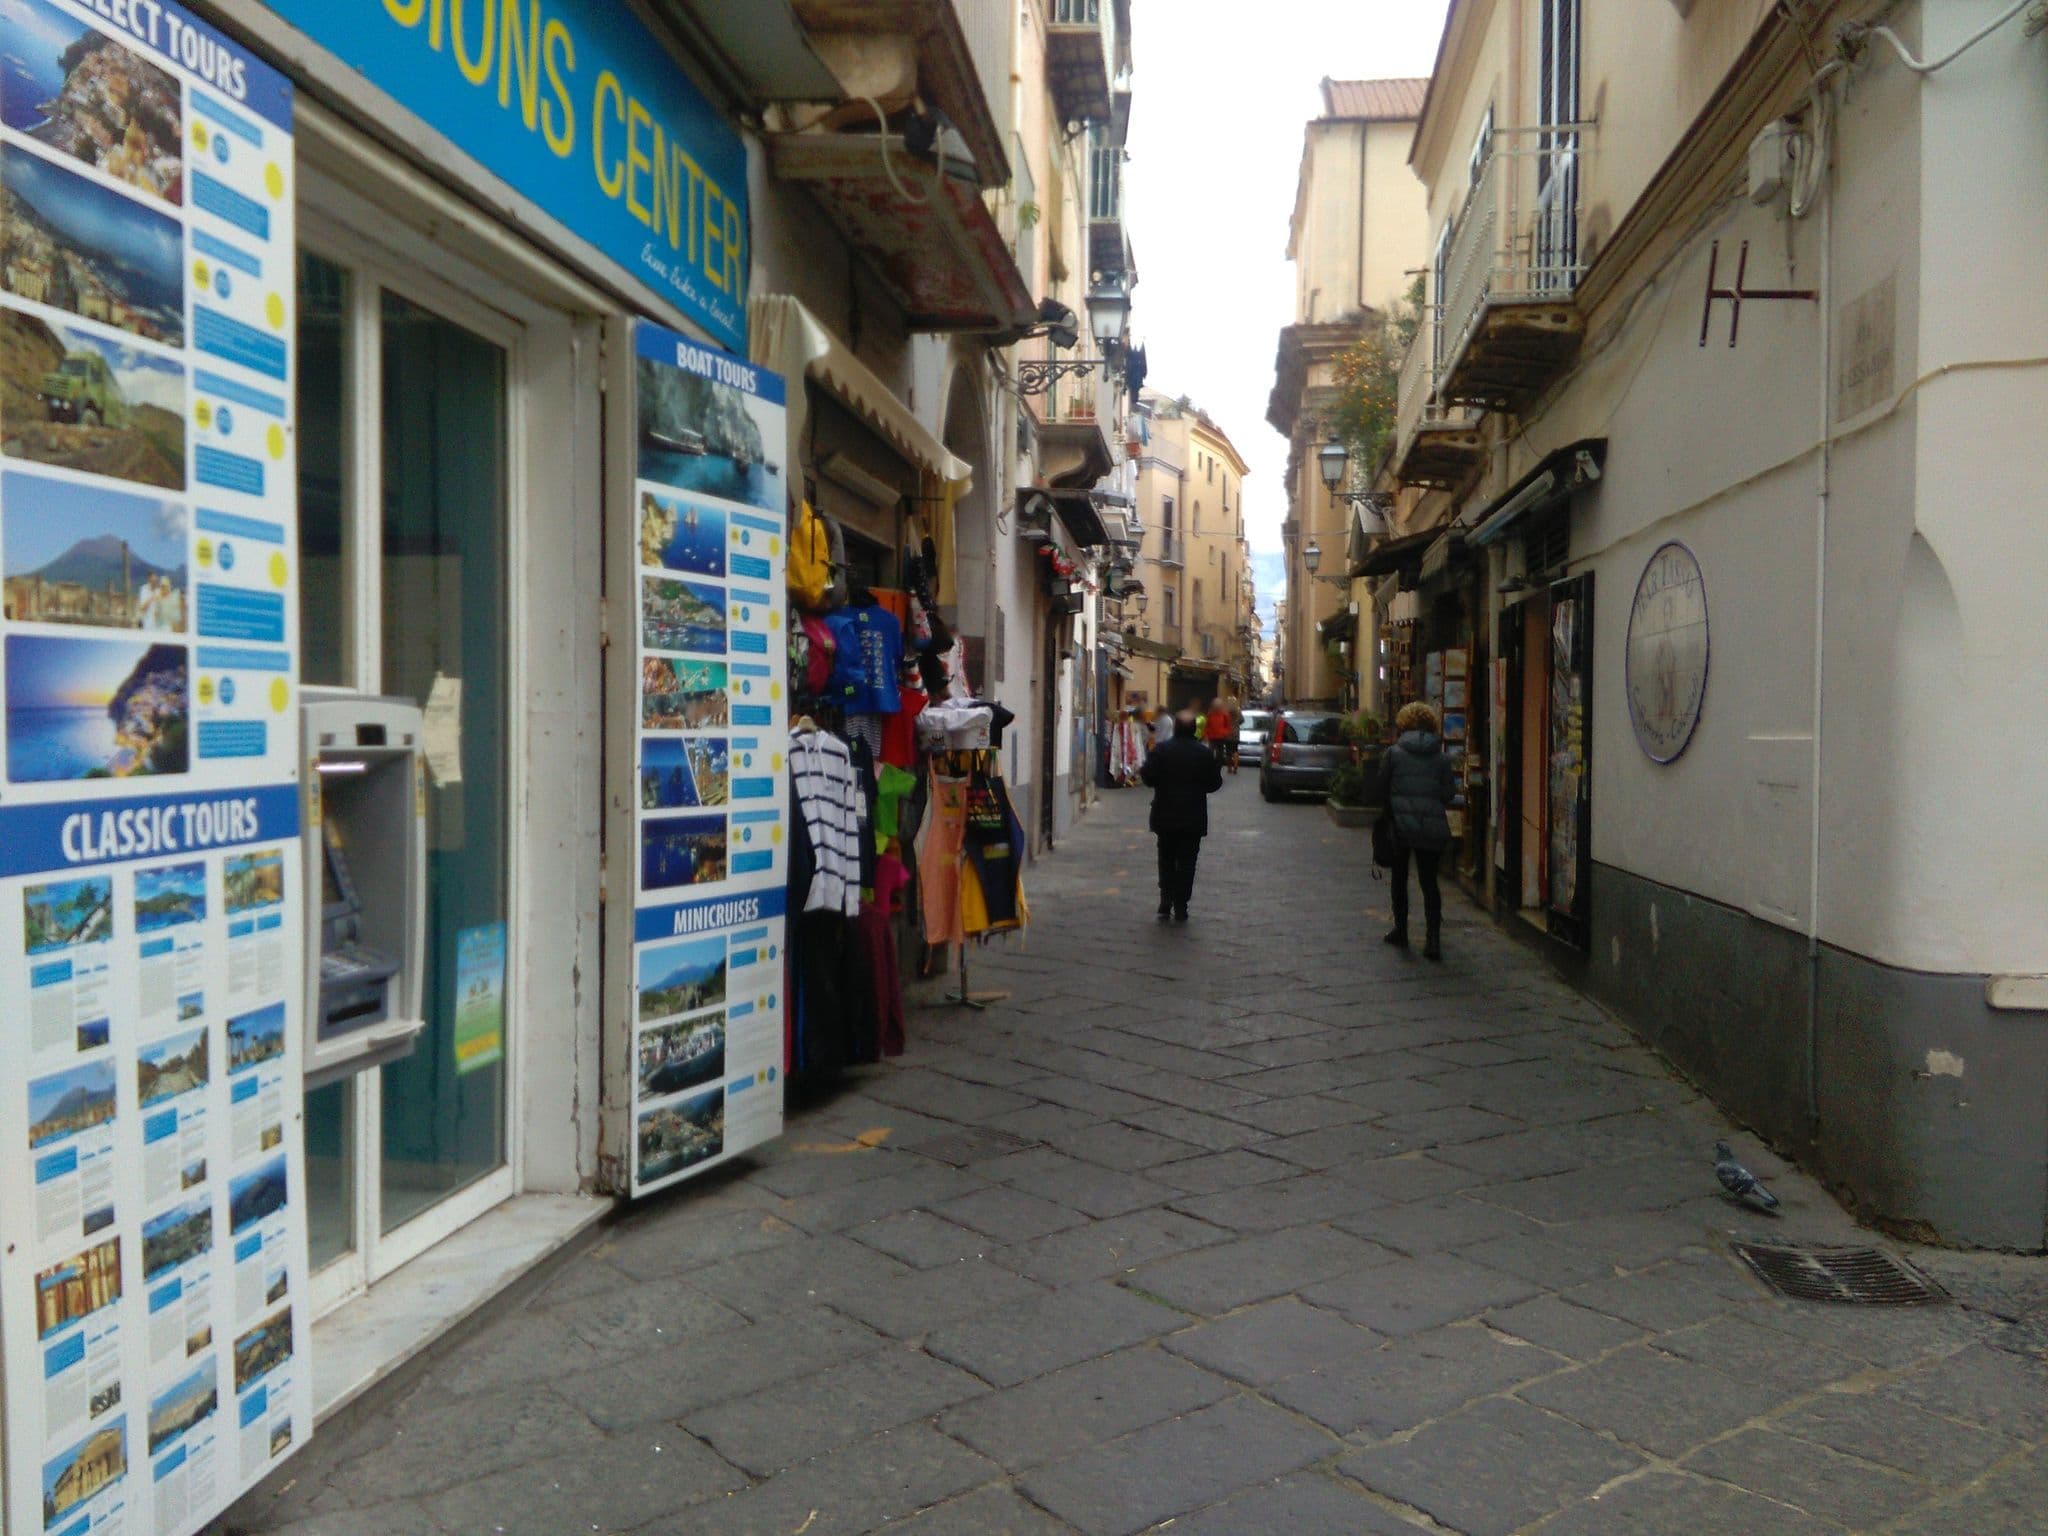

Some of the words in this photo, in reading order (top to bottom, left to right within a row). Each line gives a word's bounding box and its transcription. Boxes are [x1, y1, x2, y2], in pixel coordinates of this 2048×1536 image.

[84, 0, 162, 46] ECT
[165, 11, 247, 100] TOURS
[382, 0, 576, 159] ONS
[592, 68, 744, 307] CENTER
[676, 341, 713, 378] BOAT
[715, 356, 758, 395] TOURS
[61, 803, 178, 863] CLASSIC
[180, 797, 259, 848] TOURS
[673, 897, 760, 936] MINICRUISES
